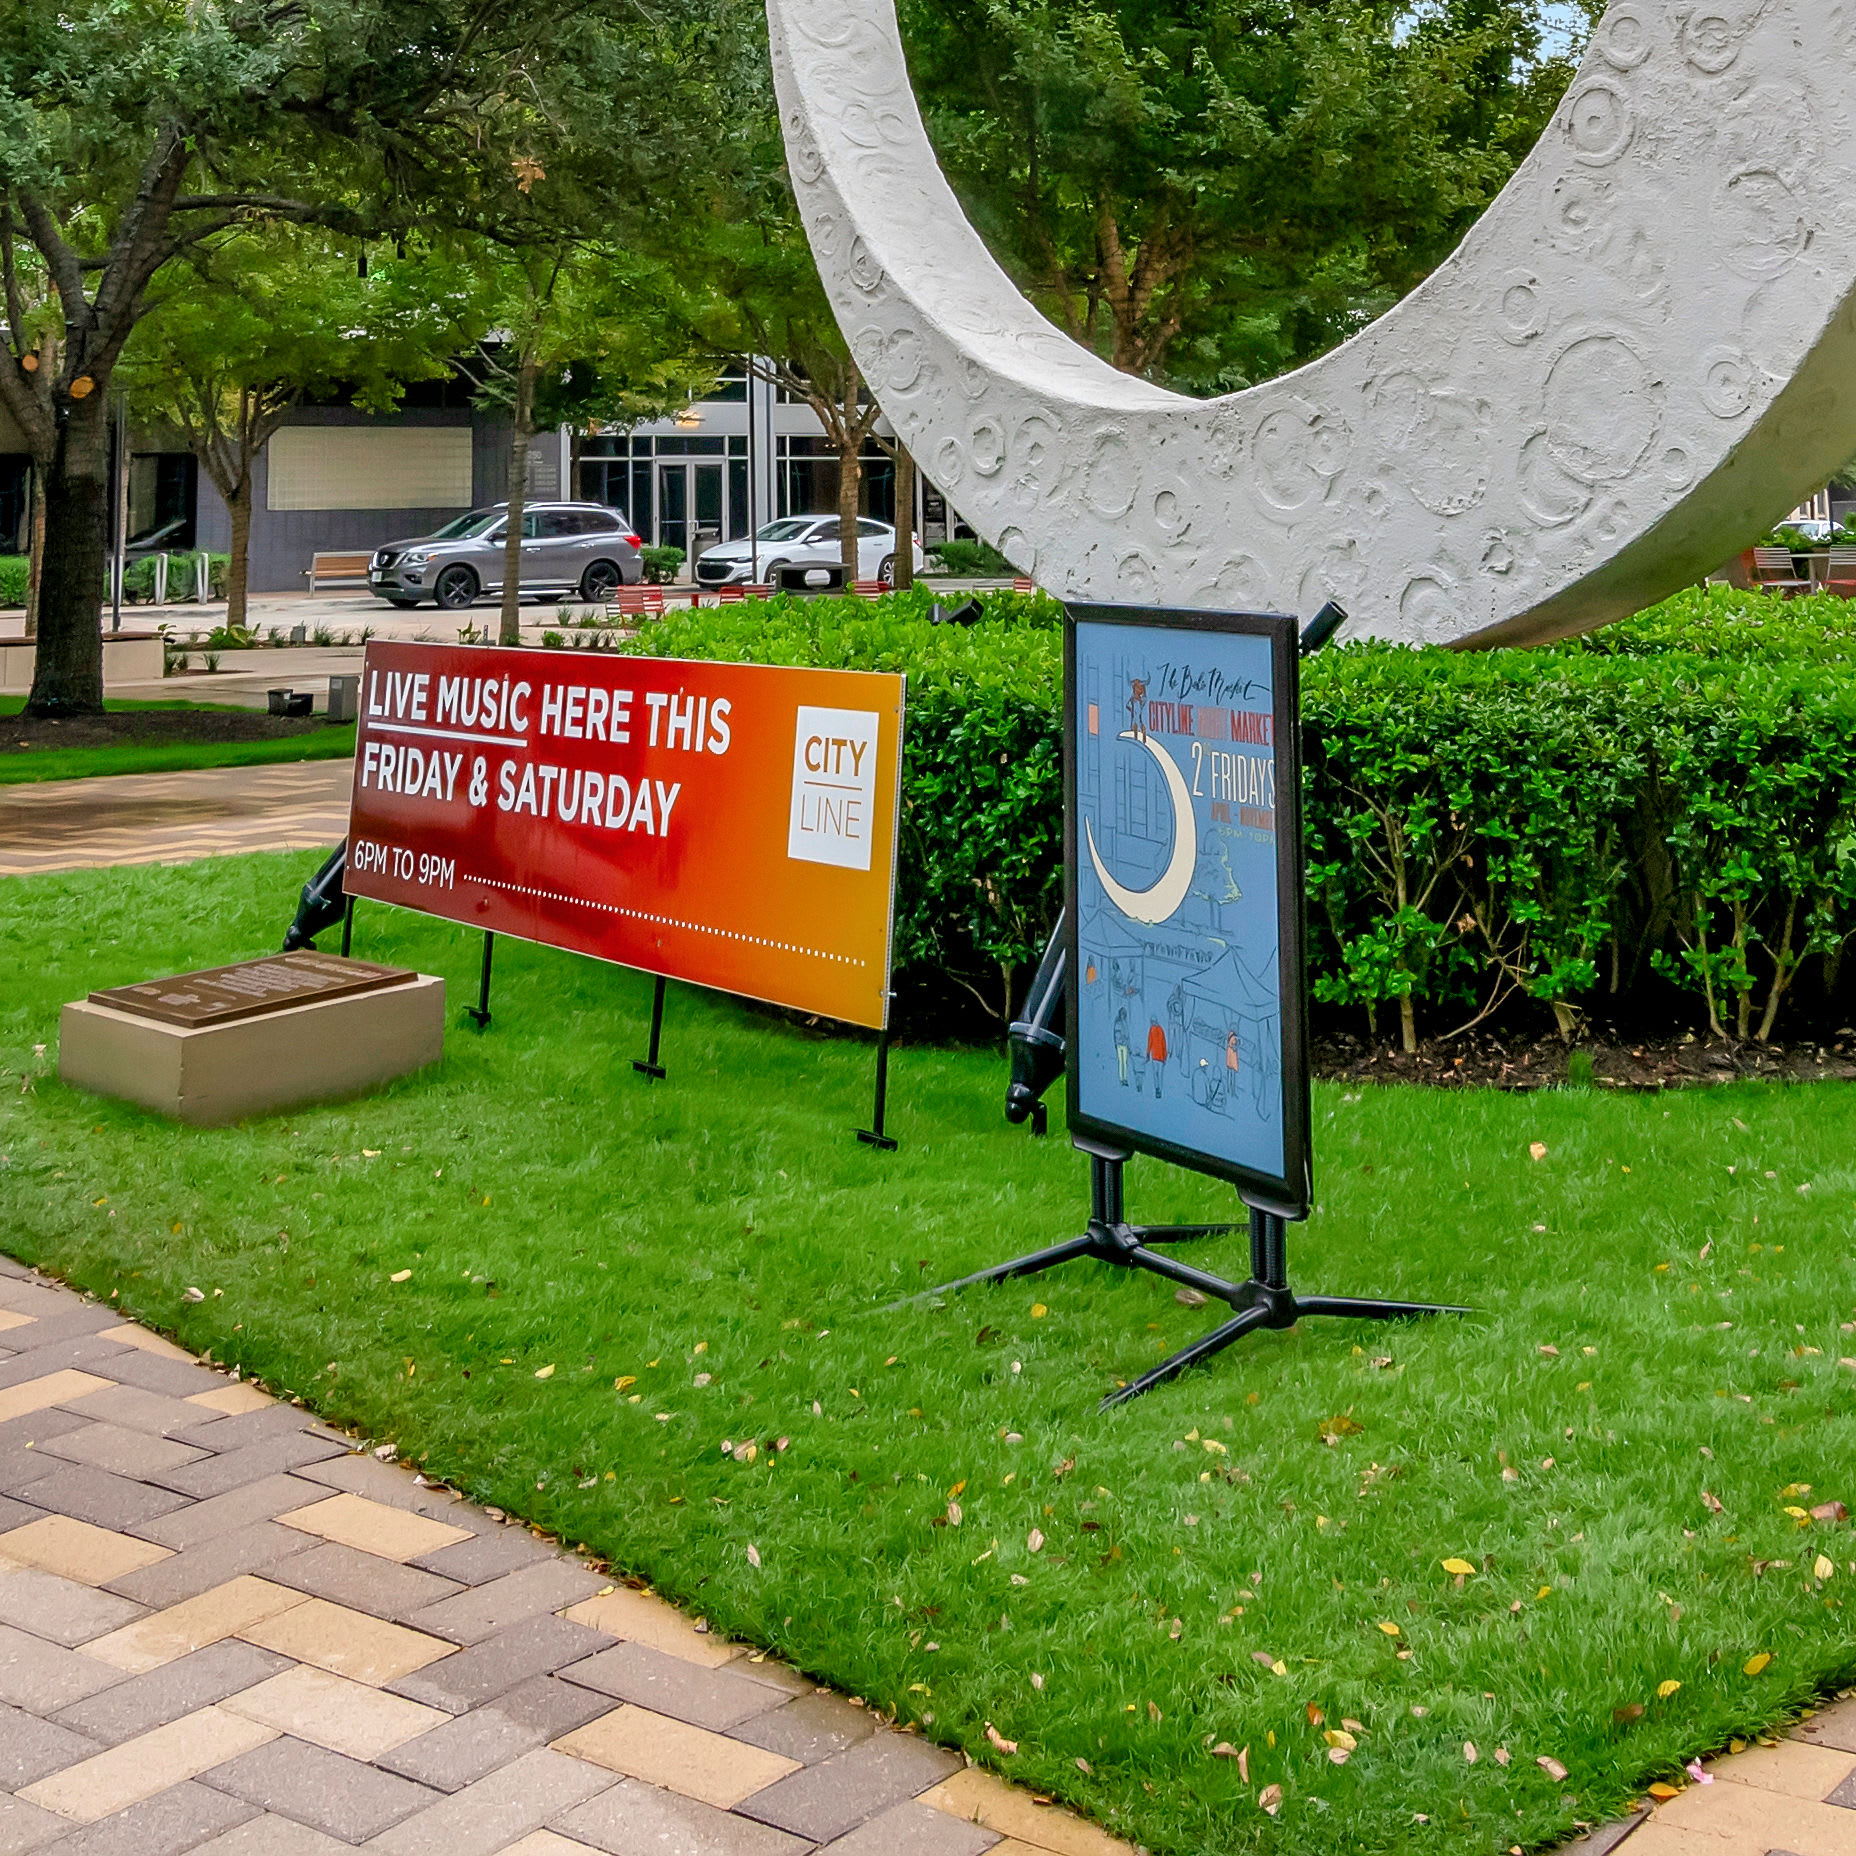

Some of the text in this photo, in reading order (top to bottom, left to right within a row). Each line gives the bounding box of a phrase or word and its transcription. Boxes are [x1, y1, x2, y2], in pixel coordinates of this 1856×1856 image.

[368, 670, 732, 755] LIVE MUSIC HERE THIS
[1148, 700, 1195, 737] CITYLINE
[804, 735, 868, 777] CITY
[1211, 751, 1275, 809] FRIDAYS
[362, 741, 682, 837] FRIDAY & SATURDAY
[800, 794, 862, 839] LINE
[354, 840, 456, 890] 6PM TO 9PM
